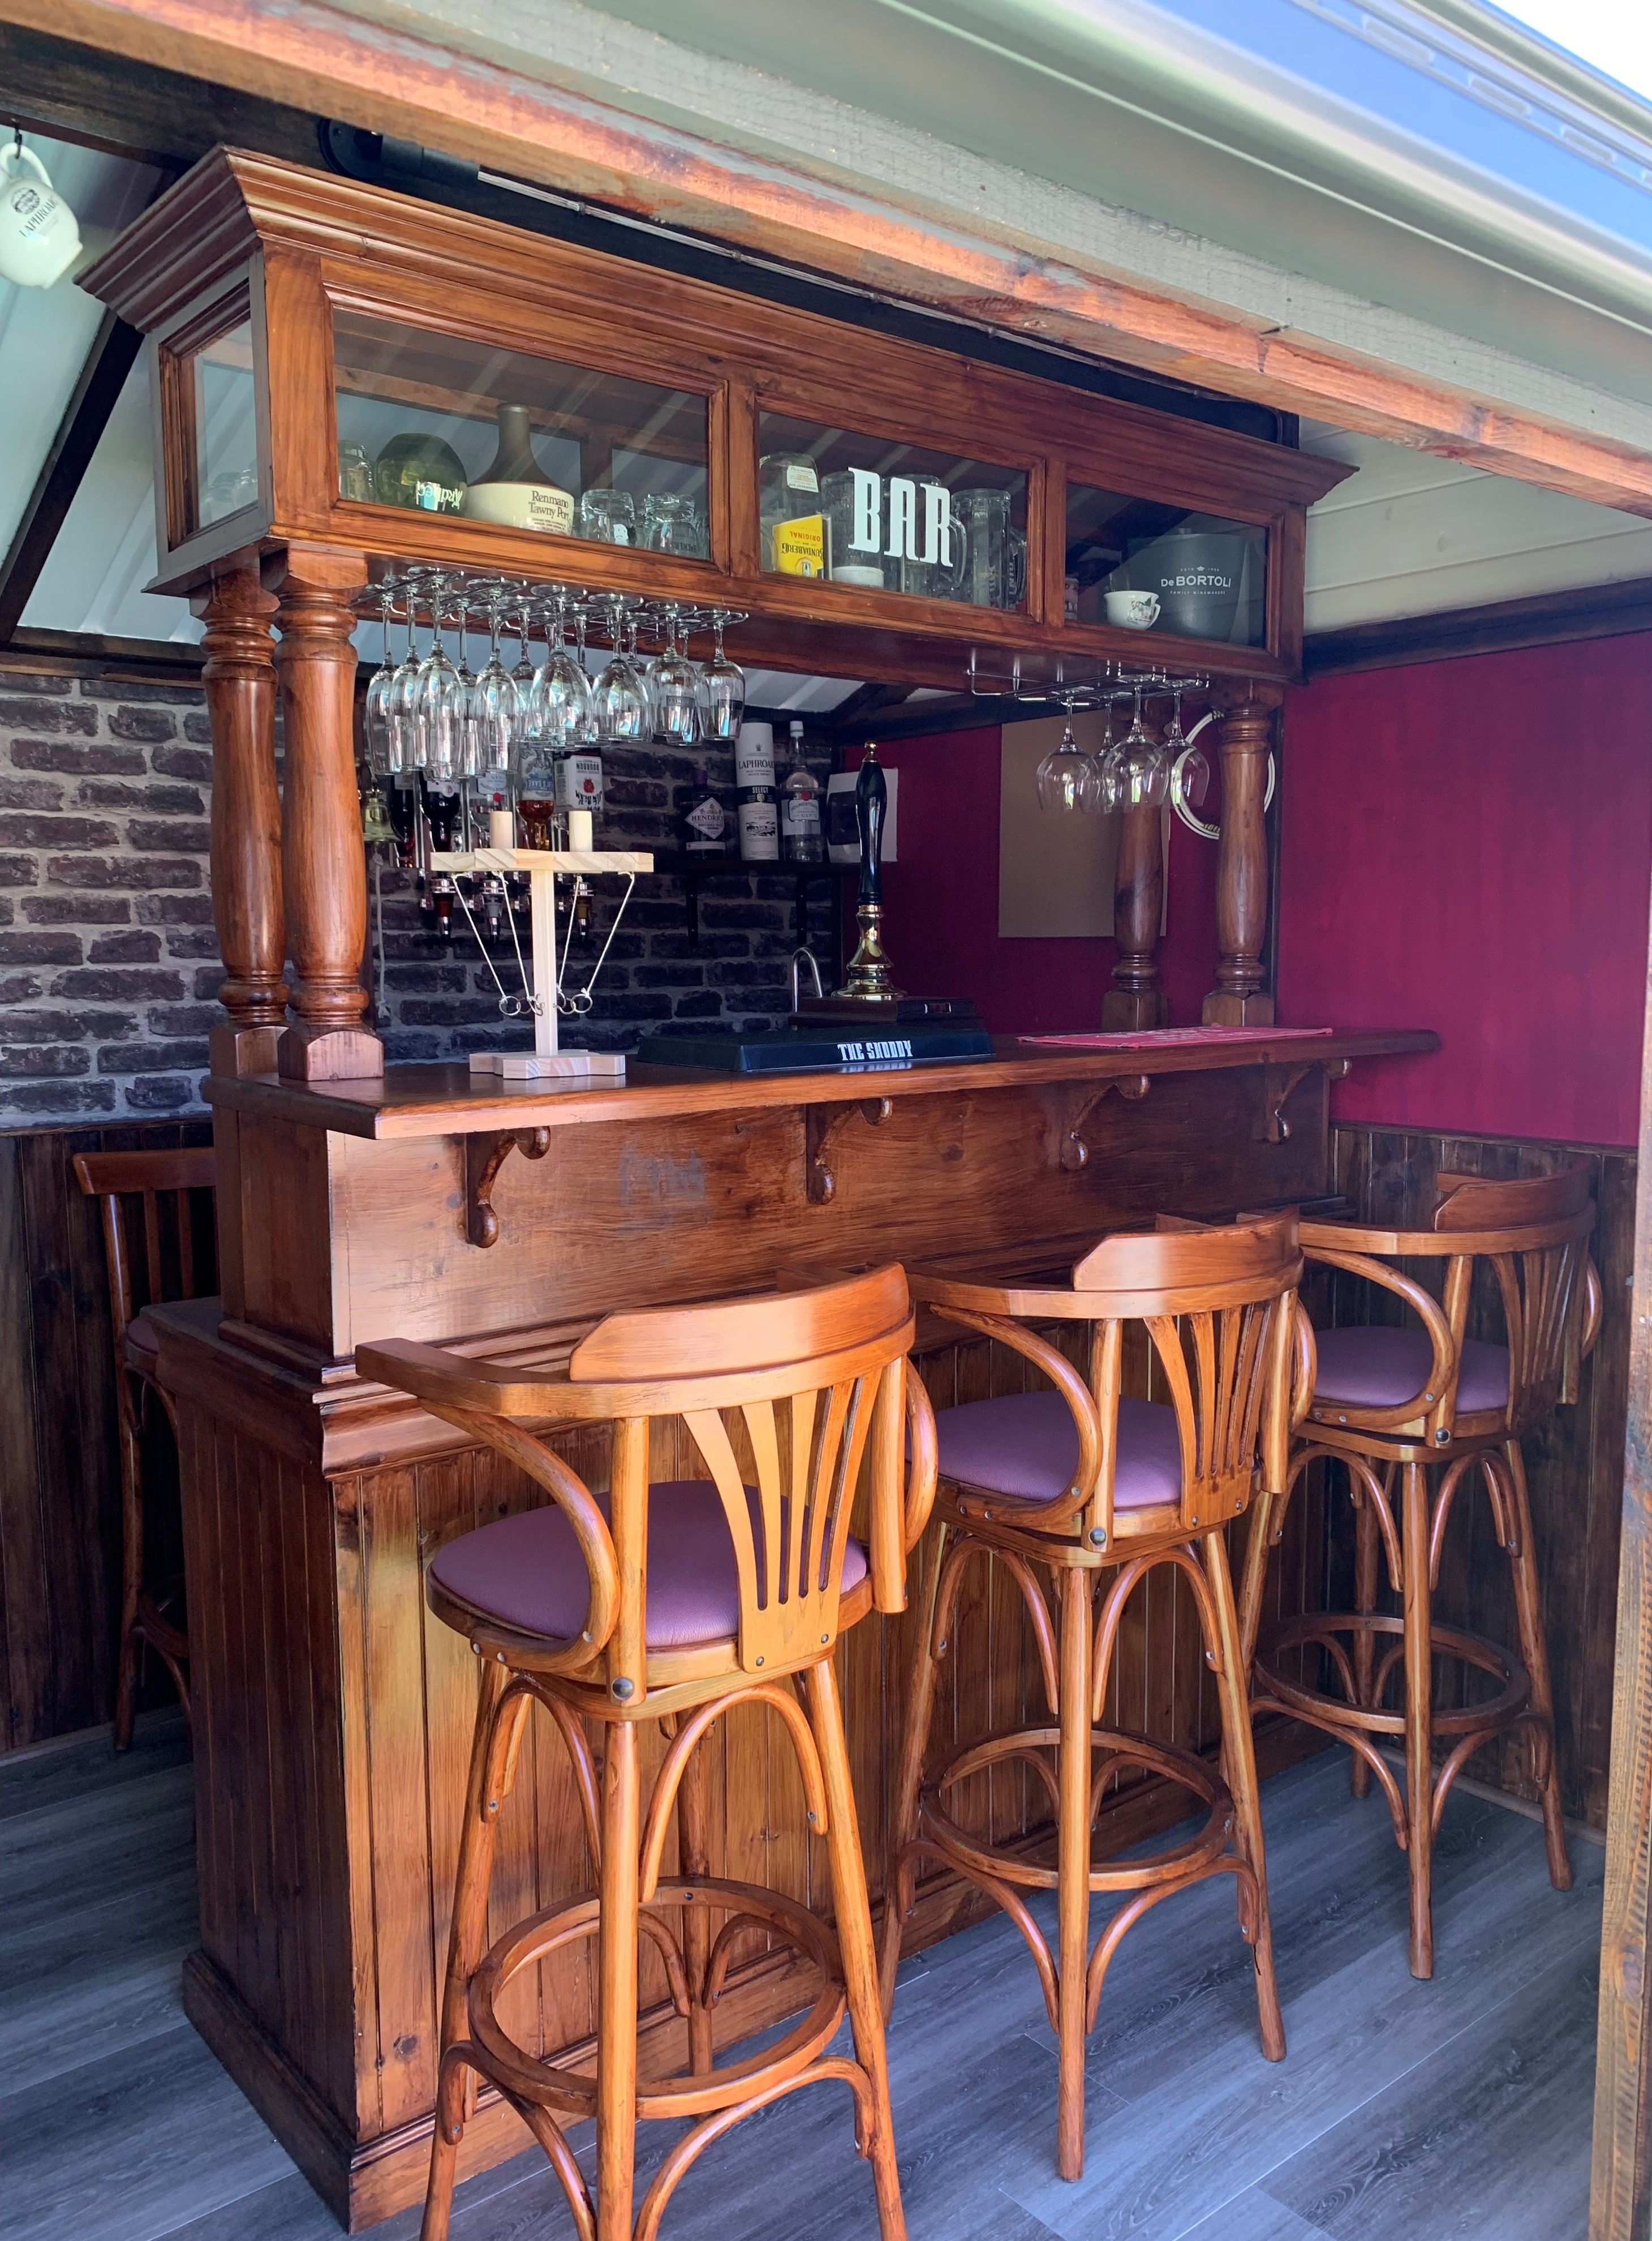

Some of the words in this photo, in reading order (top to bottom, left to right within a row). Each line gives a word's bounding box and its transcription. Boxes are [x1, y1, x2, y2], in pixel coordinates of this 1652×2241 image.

[532, 490, 569, 508] Renmano
[528, 501, 556, 519] Tawny
[848, 467, 953, 567] BAR
[789, 531, 821, 542] ORIGINAL
[1176, 575, 1231, 588] BORTOLI
[576, 762, 600, 771] BOURBON
[837, 1042, 865, 1061] THE
